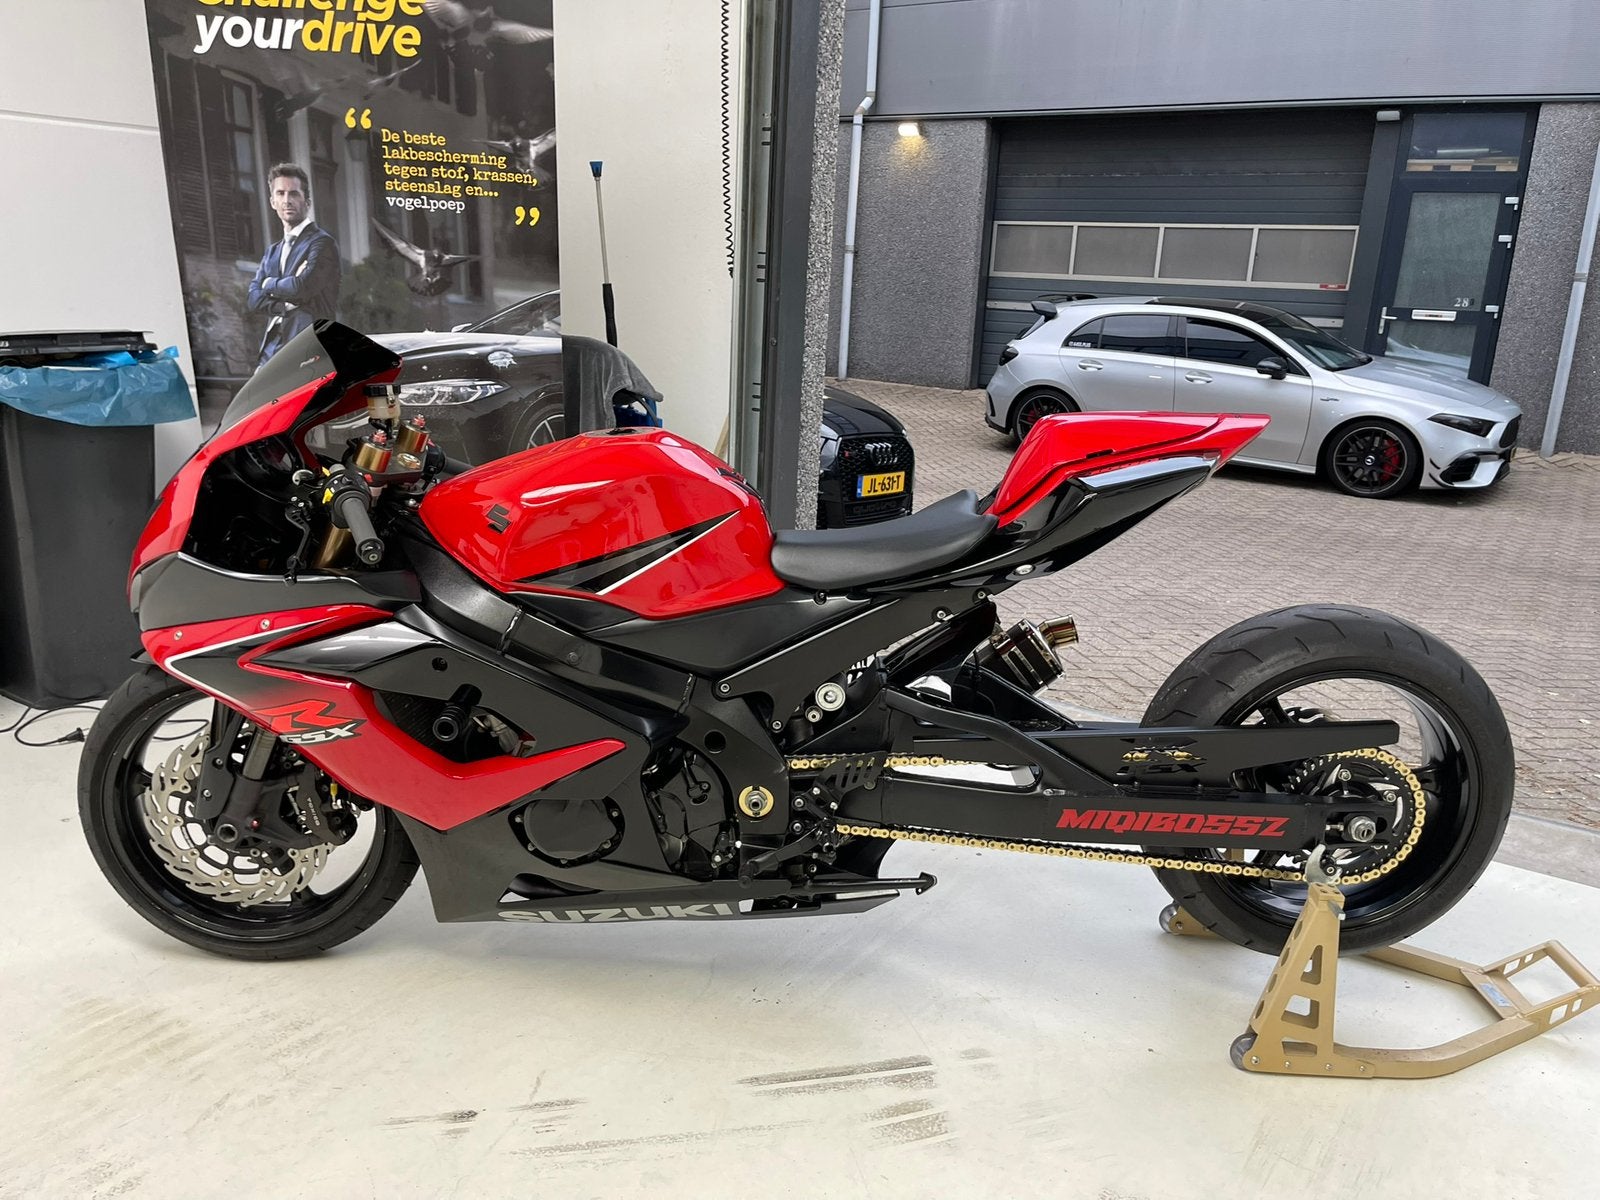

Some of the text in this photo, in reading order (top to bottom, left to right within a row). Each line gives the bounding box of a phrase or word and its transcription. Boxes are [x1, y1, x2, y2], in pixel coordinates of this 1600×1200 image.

[193, 10, 422, 58] yourdrive
[381, 128, 447, 146] De beste
[382, 146, 507, 169] lakbescherming
[383, 162, 538, 187] tegen stof, krassen,
[385, 179, 499, 197] steenslag en...
[386, 196, 466, 214] vogelpoep
[1055, 808, 1290, 837] MIQIBOSSZ
[498, 903, 733, 923] SUZUKI
